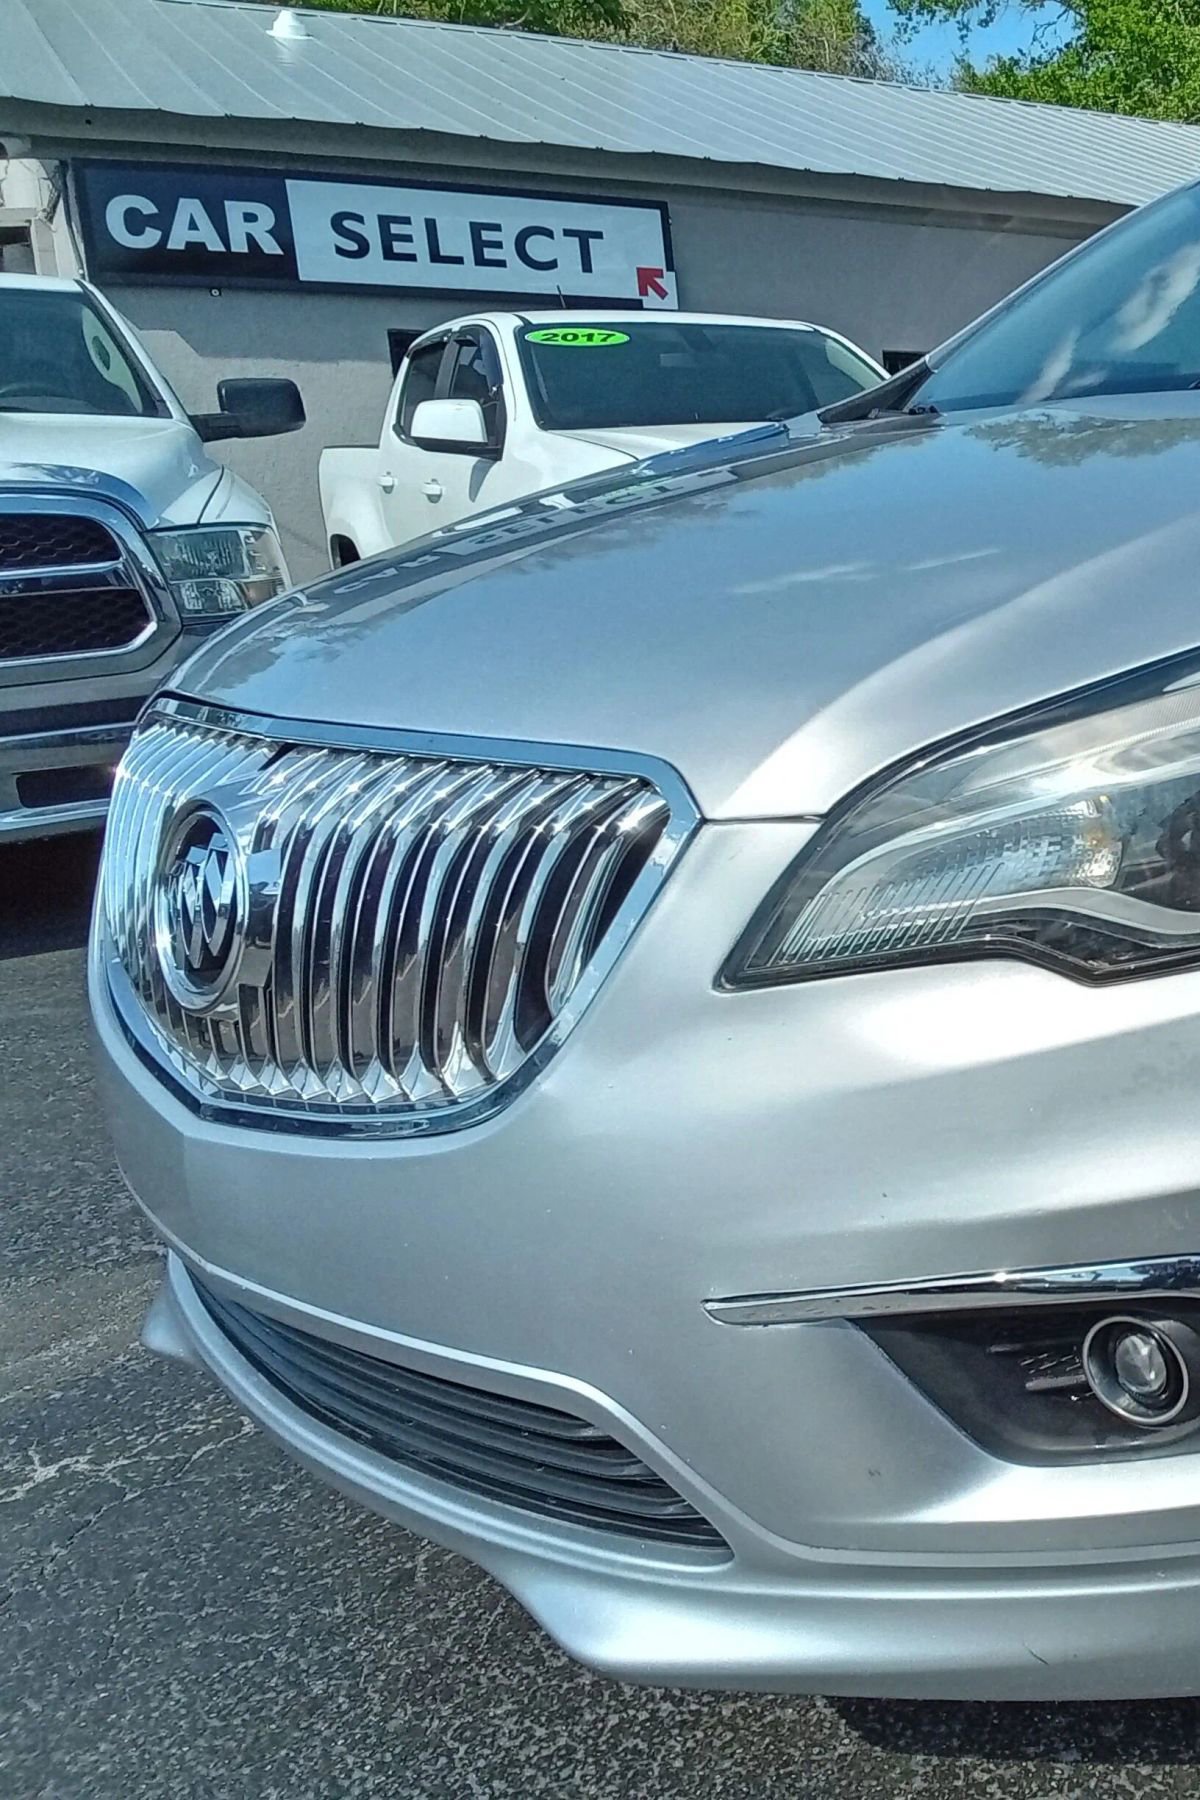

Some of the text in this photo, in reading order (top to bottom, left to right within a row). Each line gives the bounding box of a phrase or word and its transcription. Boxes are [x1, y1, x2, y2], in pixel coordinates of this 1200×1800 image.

[104, 193, 605, 274] CAR SELECT
[540, 332, 616, 342] 2017
